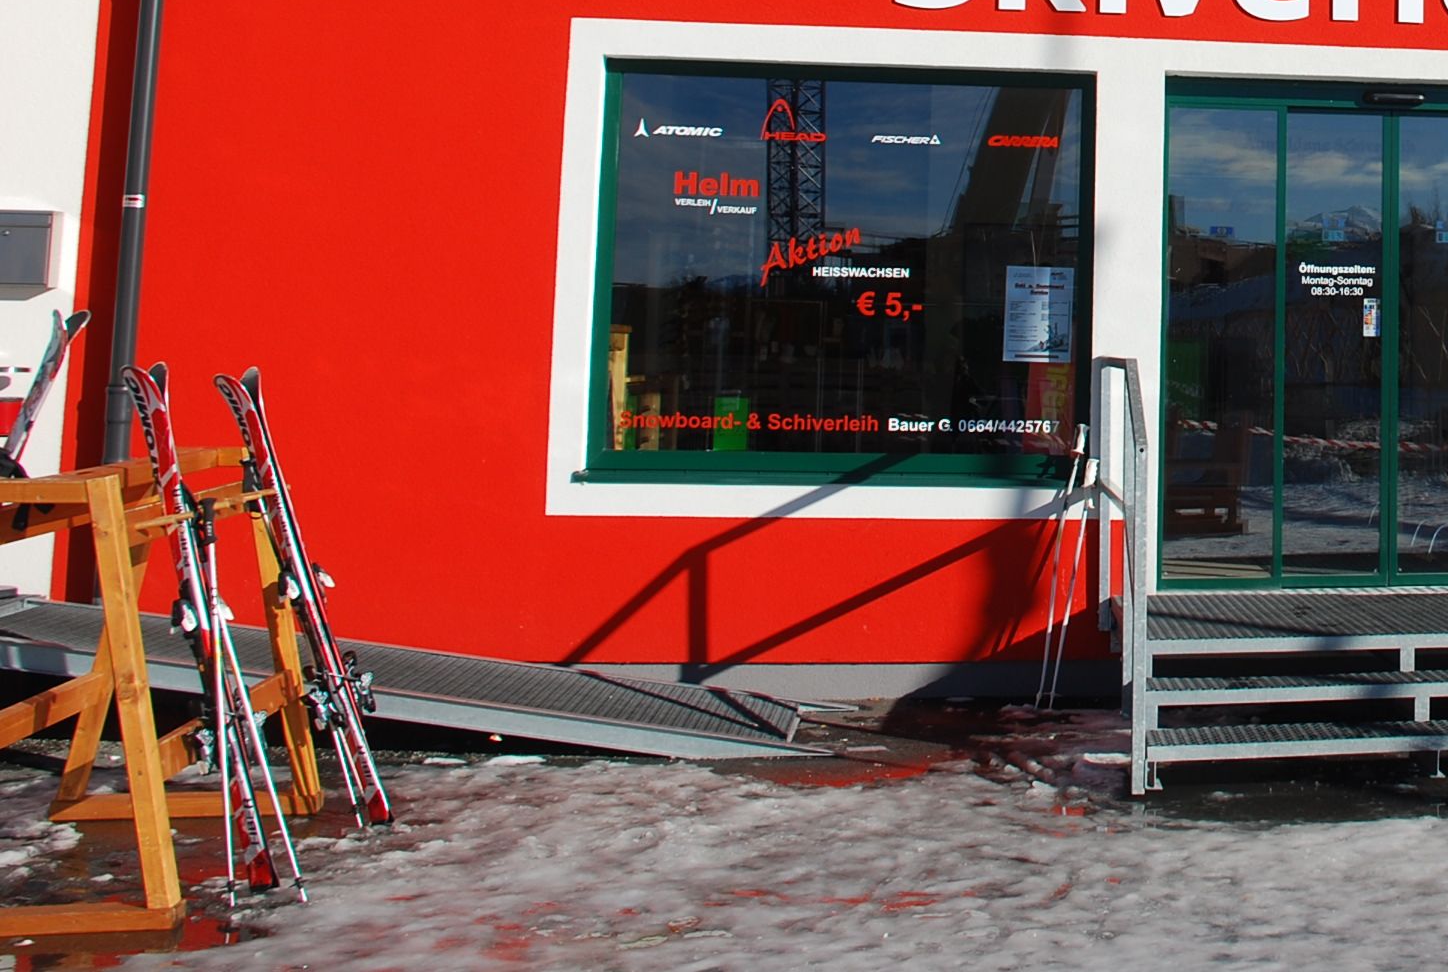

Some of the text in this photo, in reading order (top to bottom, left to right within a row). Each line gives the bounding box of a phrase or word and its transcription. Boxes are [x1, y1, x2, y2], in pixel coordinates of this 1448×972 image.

[653, 125, 723, 137] ATOMIC
[763, 131, 828, 142] HEAD
[872, 135, 930, 145] FISCHER
[988, 135, 1059, 147] CARRERA
[673, 171, 760, 197] Helm
[760, 227, 862, 288] Aktion
[812, 266, 910, 279] HEISSWACHSEN
[1299, 261, 1376, 275] Öffnungszeiten:
[1301, 276, 1373, 287] Montag-Sonntag
[1311, 287, 1364, 296] 08:30-16:30
[856, 291, 876, 317] €
[619, 411, 1060, 433] Snowboard- & Schiverleih Bauer G. 0664/4425767
[124, 377, 163, 488] ATOMIC
